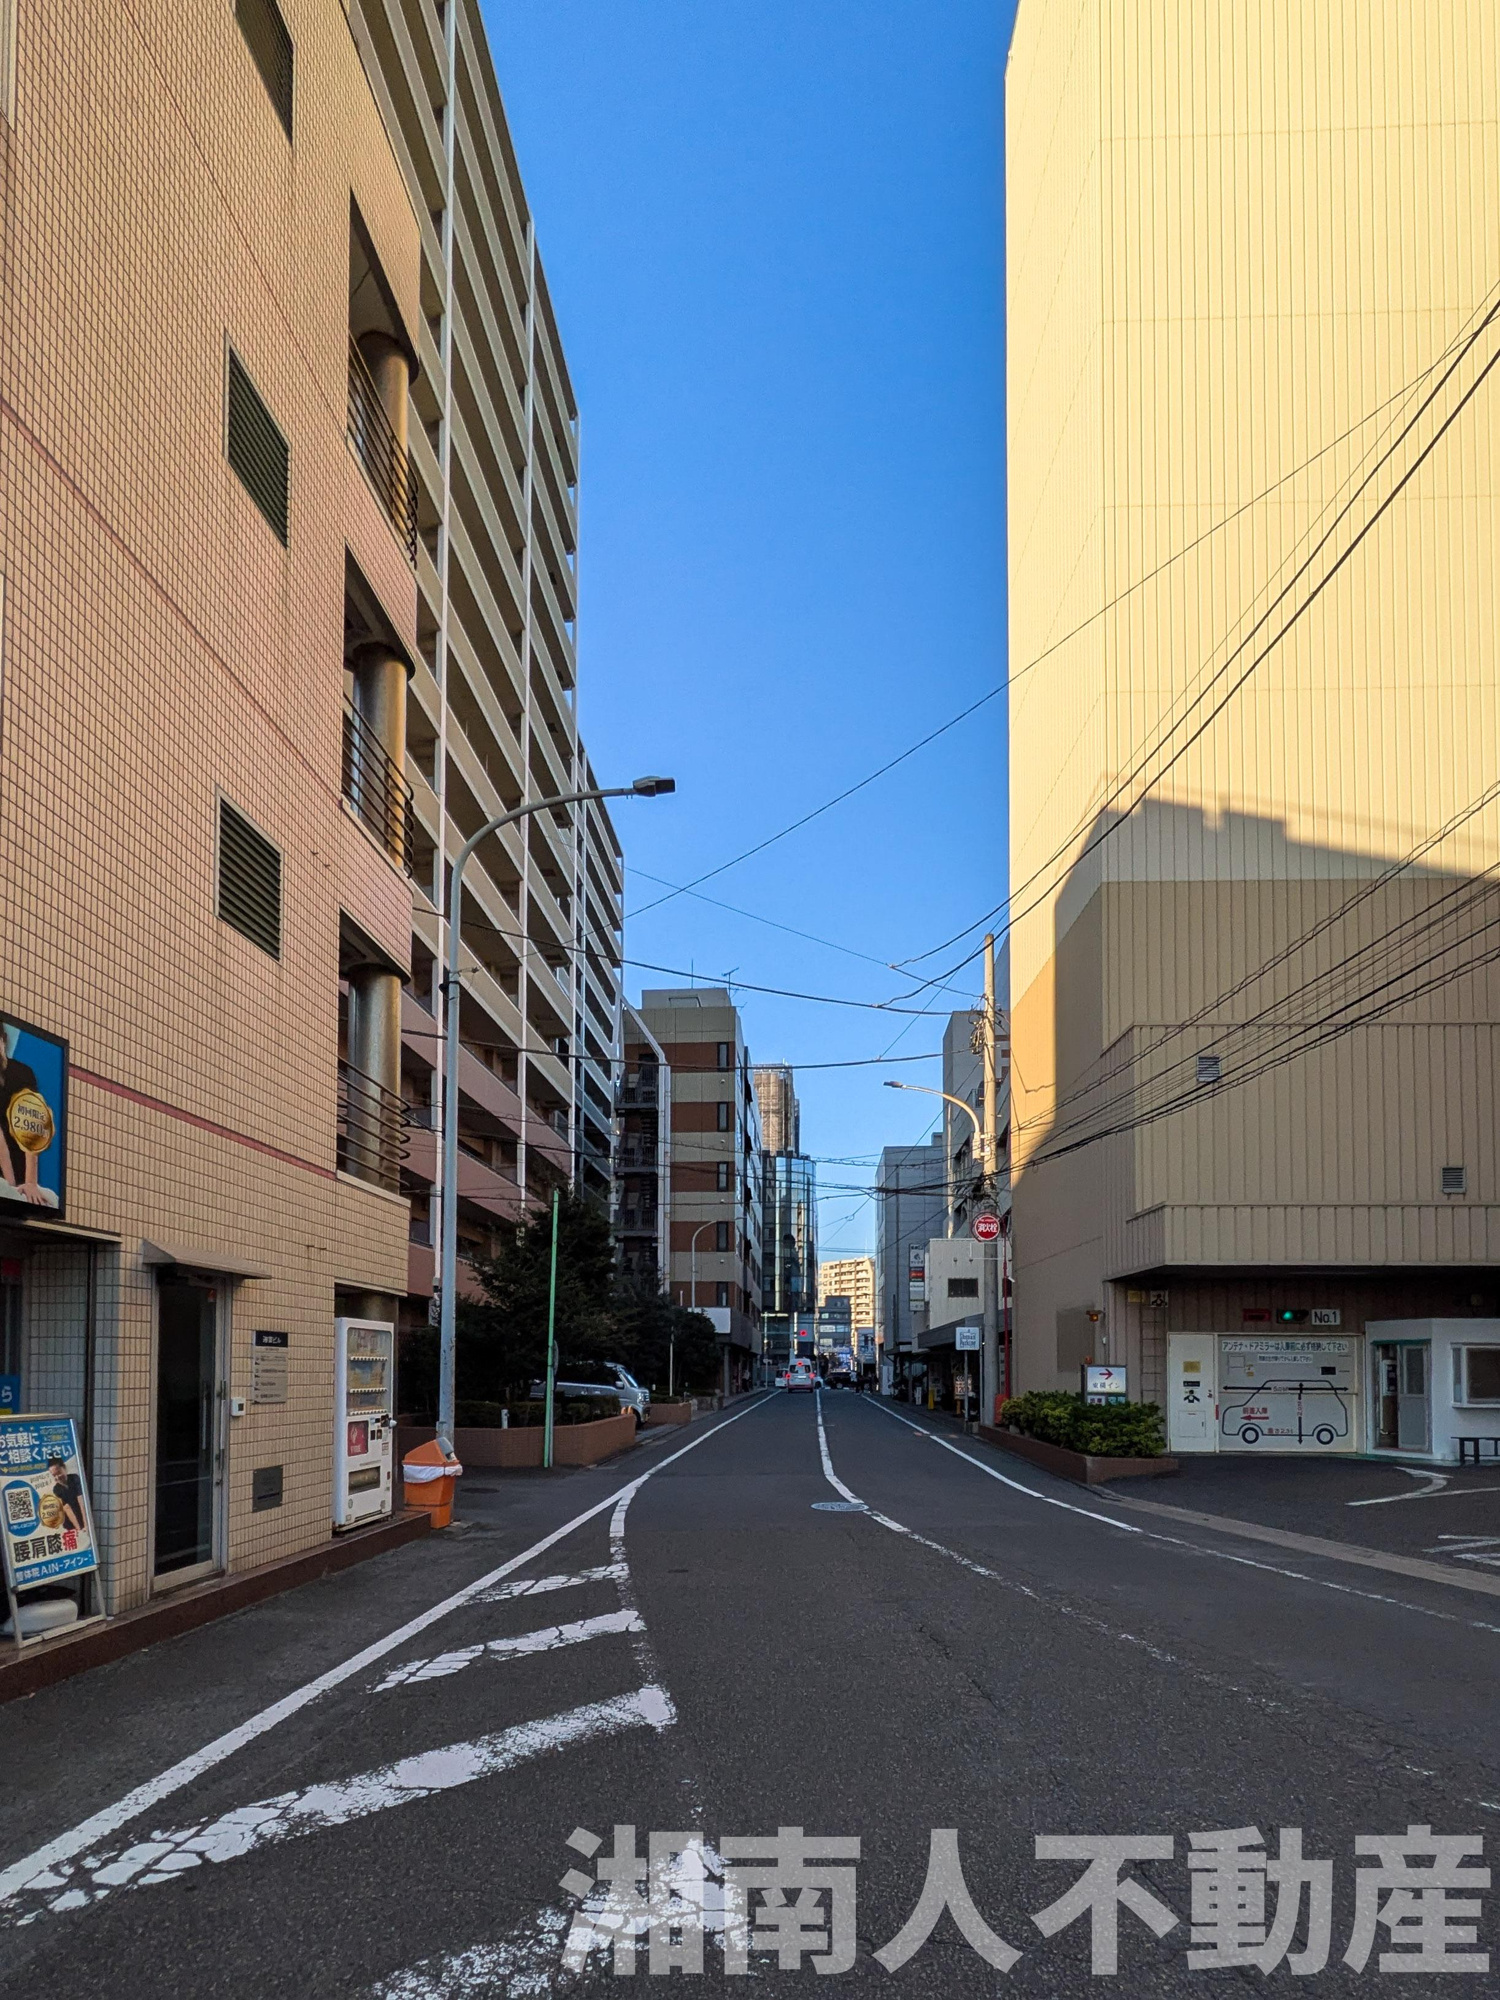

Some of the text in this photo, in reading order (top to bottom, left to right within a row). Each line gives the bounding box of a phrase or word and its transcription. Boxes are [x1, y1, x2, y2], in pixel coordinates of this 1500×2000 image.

[978, 1222, 998, 1233] 消火栓
[1314, 1311, 1337, 1324] No.1
[0, 1445, 73, 1465] ご相談ください
